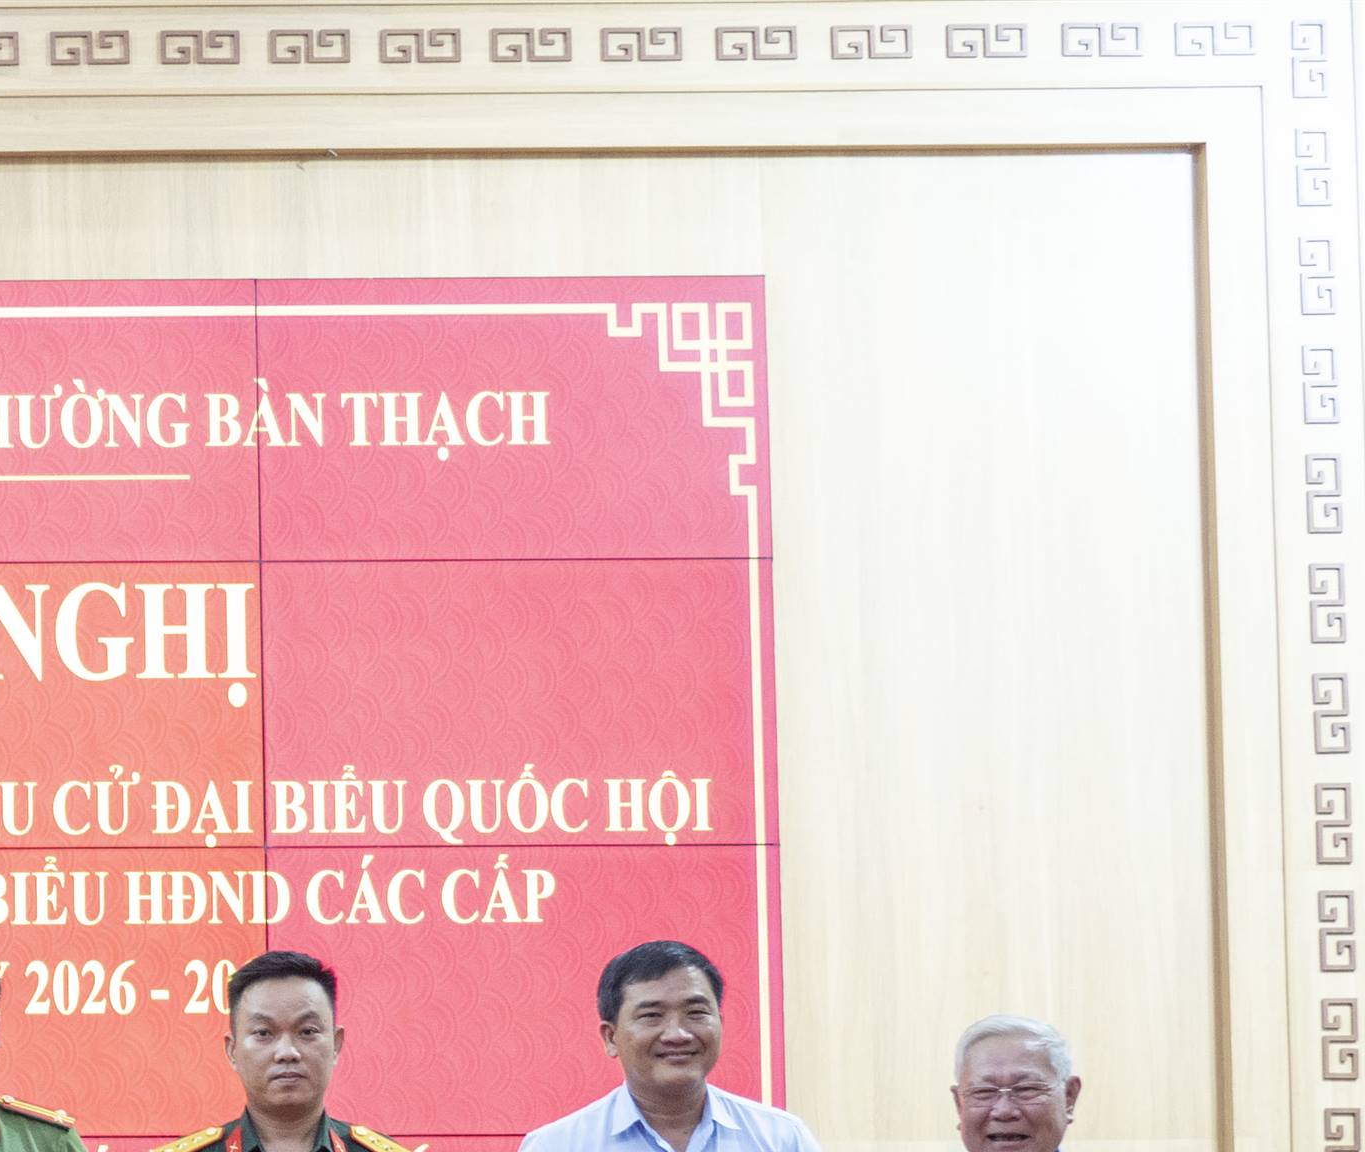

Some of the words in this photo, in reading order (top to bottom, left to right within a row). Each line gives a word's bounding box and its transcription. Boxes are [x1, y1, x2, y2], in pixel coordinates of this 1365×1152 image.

[204, 378, 326, 447] BÀN
[340, 391, 551, 462] THẠCH
[52, 764, 141, 836] CỬ
[151, 779, 254, 848] ĐẠI
[271, 764, 407, 835] BIỂU
[422, 763, 589, 846] QUỐC
[603, 769, 713, 846] HỘI
[123, 870, 290, 926] HĐND
[306, 854, 425, 925] CÁC
[441, 853, 556, 924] CẤP
[24, 959, 137, 1015] 2026
[183, 959, 237, 1015] 20
